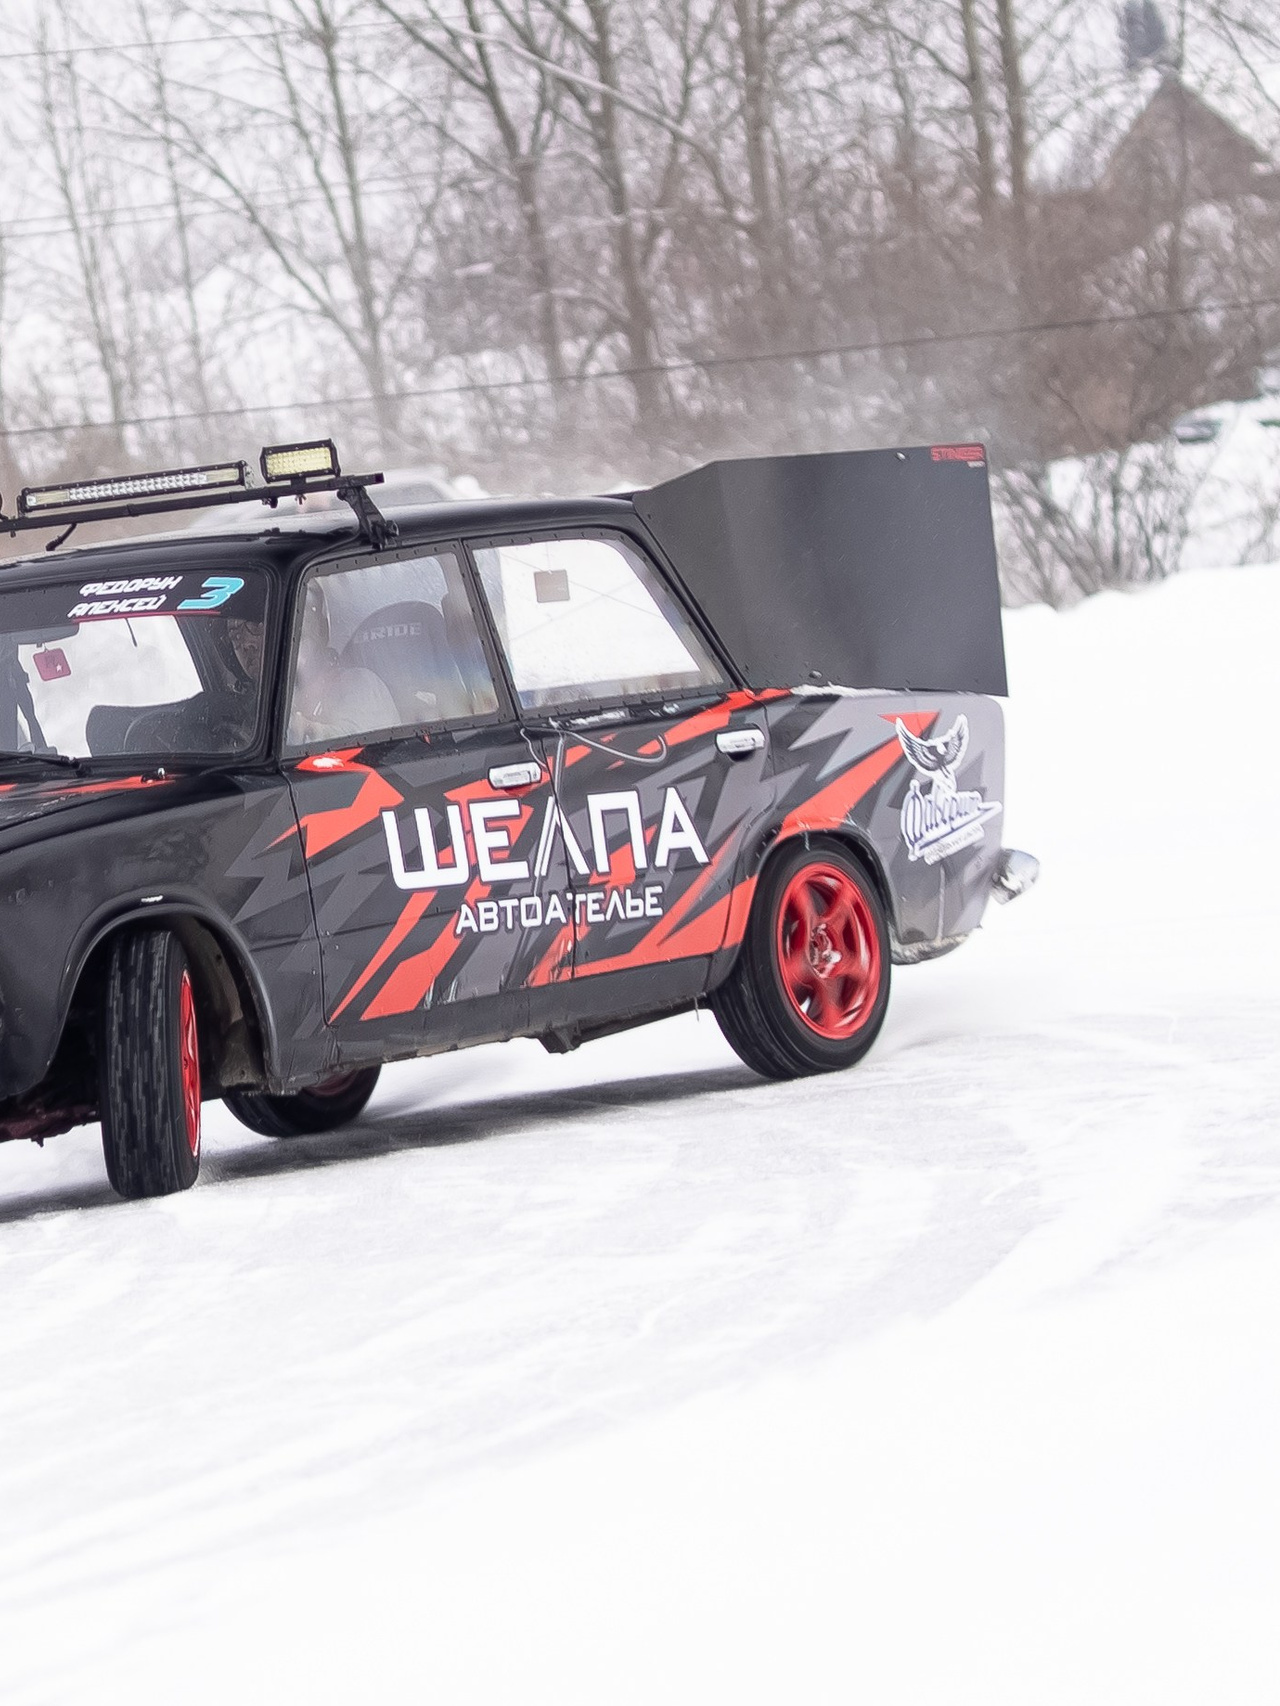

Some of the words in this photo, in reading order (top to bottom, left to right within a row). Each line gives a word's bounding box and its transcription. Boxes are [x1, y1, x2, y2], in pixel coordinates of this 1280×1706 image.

[176, 576, 245, 611] 3
[382, 787, 710, 889] ШЕЛПА
[455, 885, 663, 935] АВТОАТЕЛЬЕ
